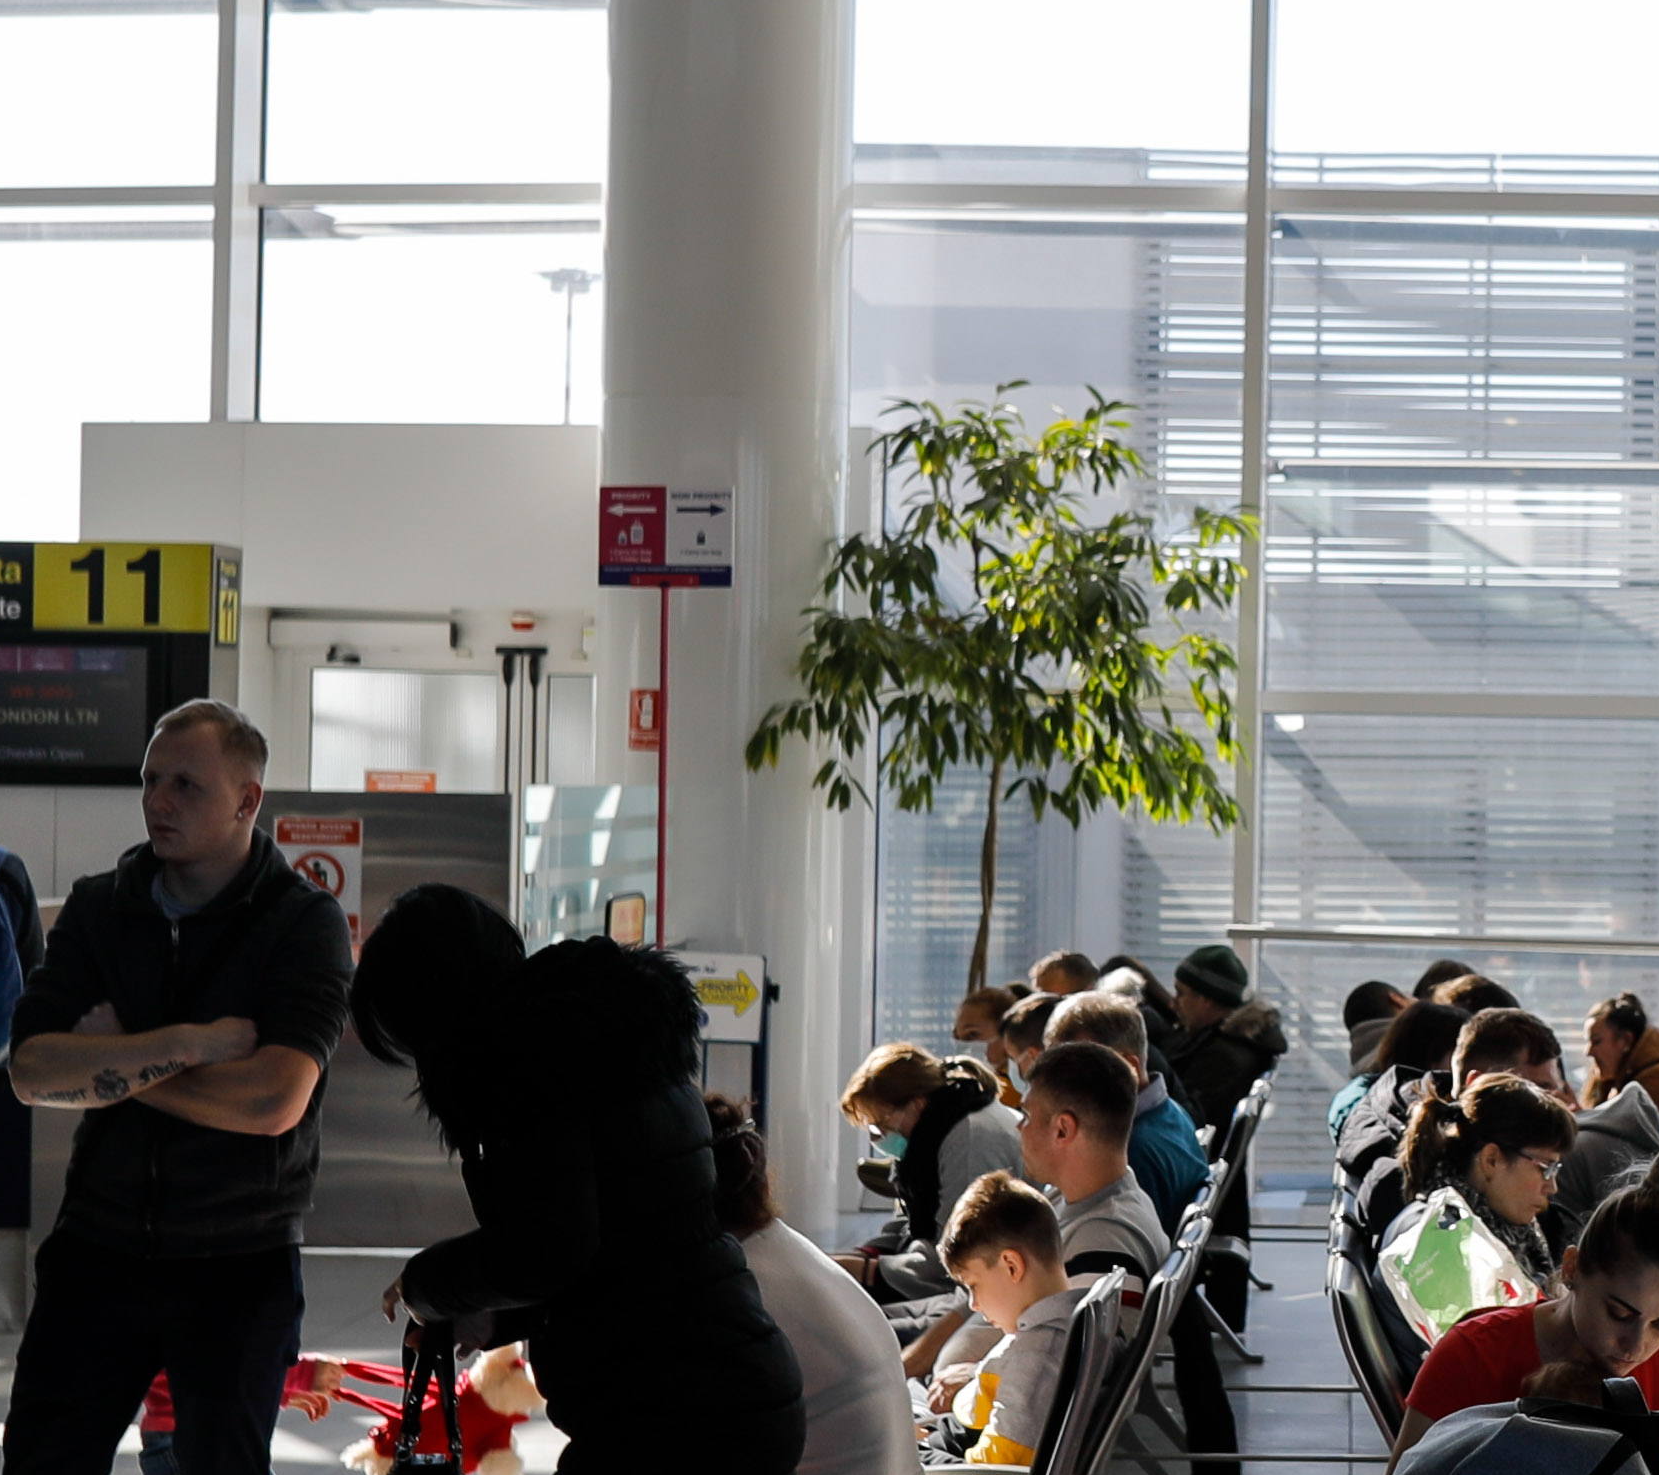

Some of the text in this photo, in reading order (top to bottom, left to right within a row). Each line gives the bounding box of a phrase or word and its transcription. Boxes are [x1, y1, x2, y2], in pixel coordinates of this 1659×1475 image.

[611, 491, 652, 501] PRIORITY
[70, 547, 161, 625] 11
[64, 707, 100, 726] LTN
